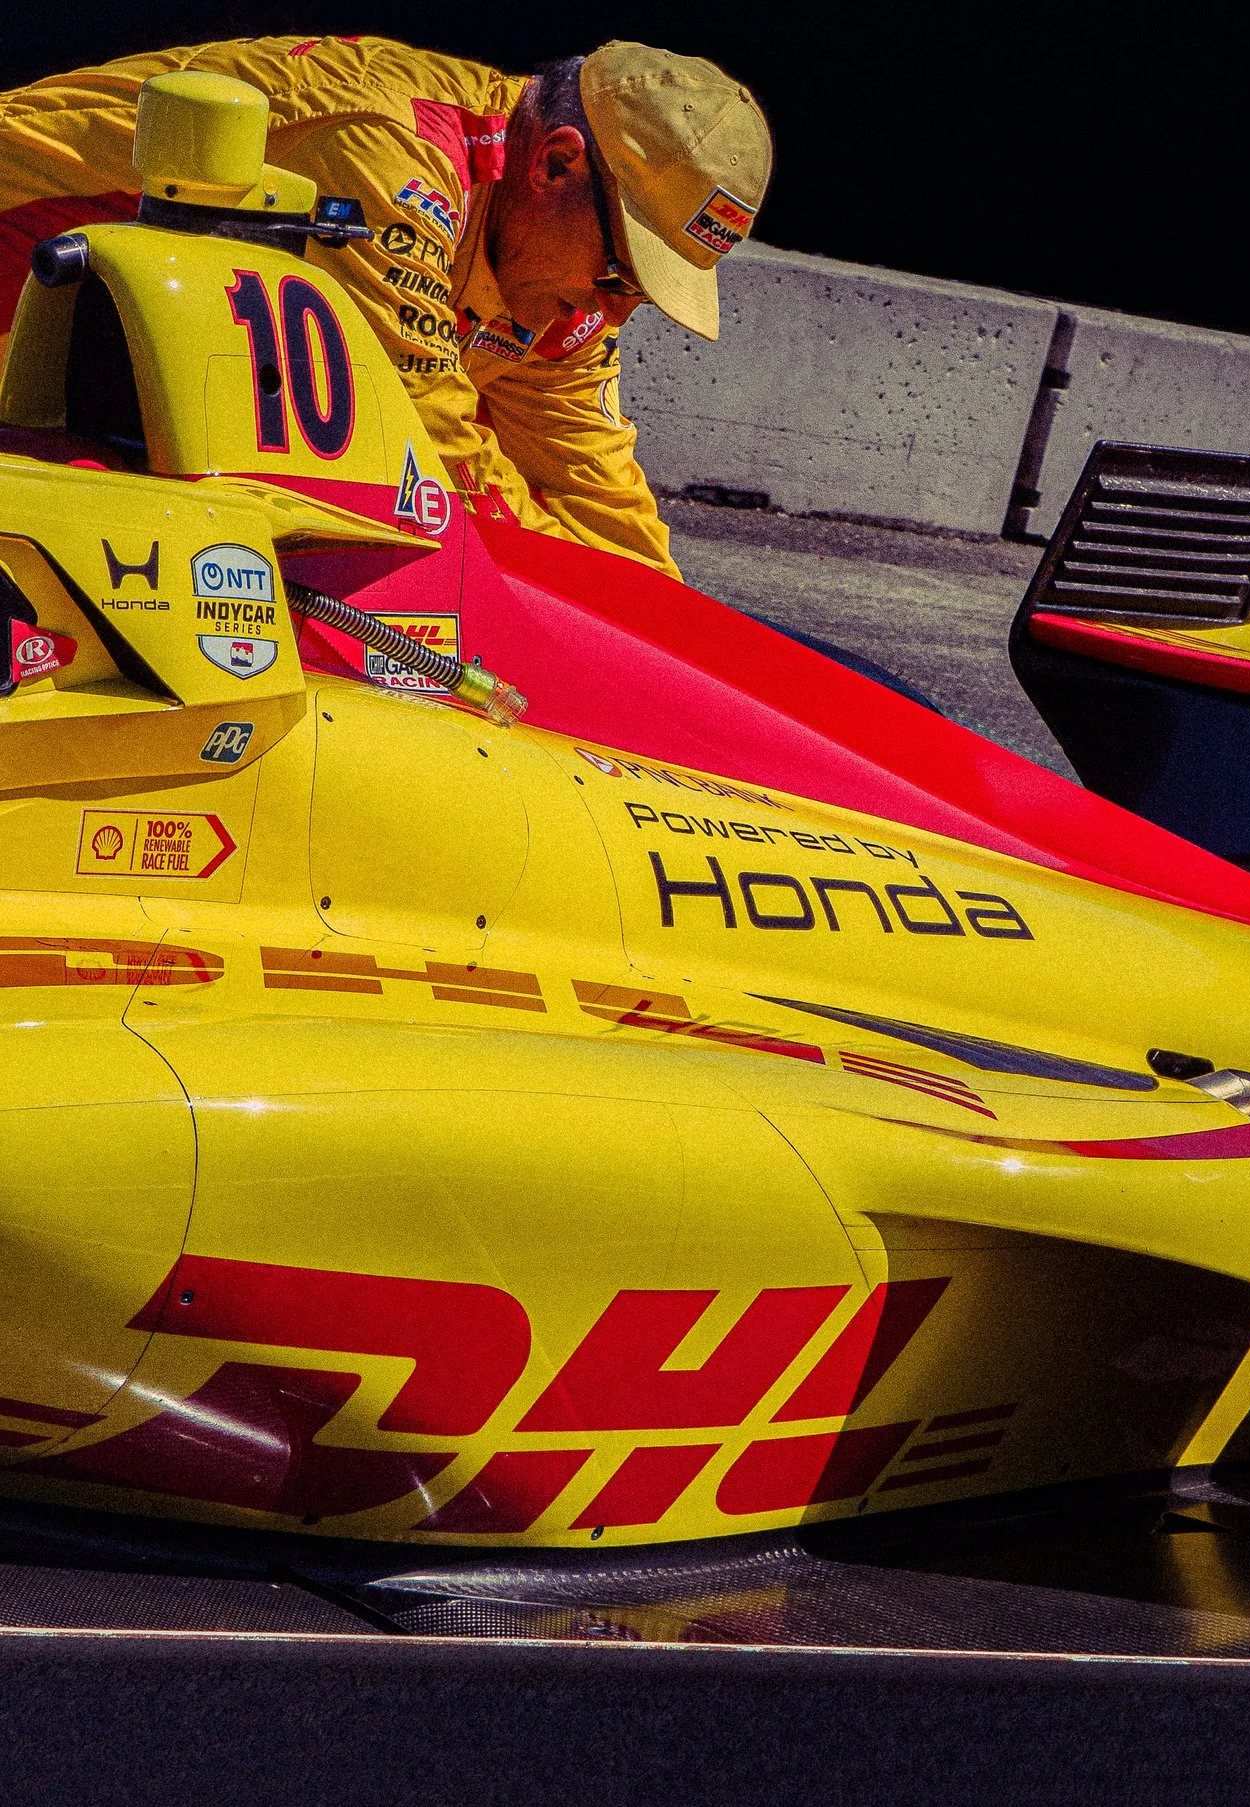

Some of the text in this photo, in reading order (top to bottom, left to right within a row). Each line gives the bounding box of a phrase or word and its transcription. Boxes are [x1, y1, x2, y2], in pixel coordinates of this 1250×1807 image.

[224, 268, 355, 460] 10
[227, 568, 266, 591] NTT
[101, 598, 170, 611] Honda
[196, 601, 276, 625] INDYCAR
[215, 621, 262, 635] SERIES
[205, 726, 250, 758] PPG
[147, 820, 192, 838] 100%
[623, 802, 919, 869] Powered by
[143, 839, 191, 852] RENEWABLE
[141, 852, 190, 871] RACE FUEL
[648, 850, 1036, 941] Honda
[4, 1254, 952, 1536] DHL
